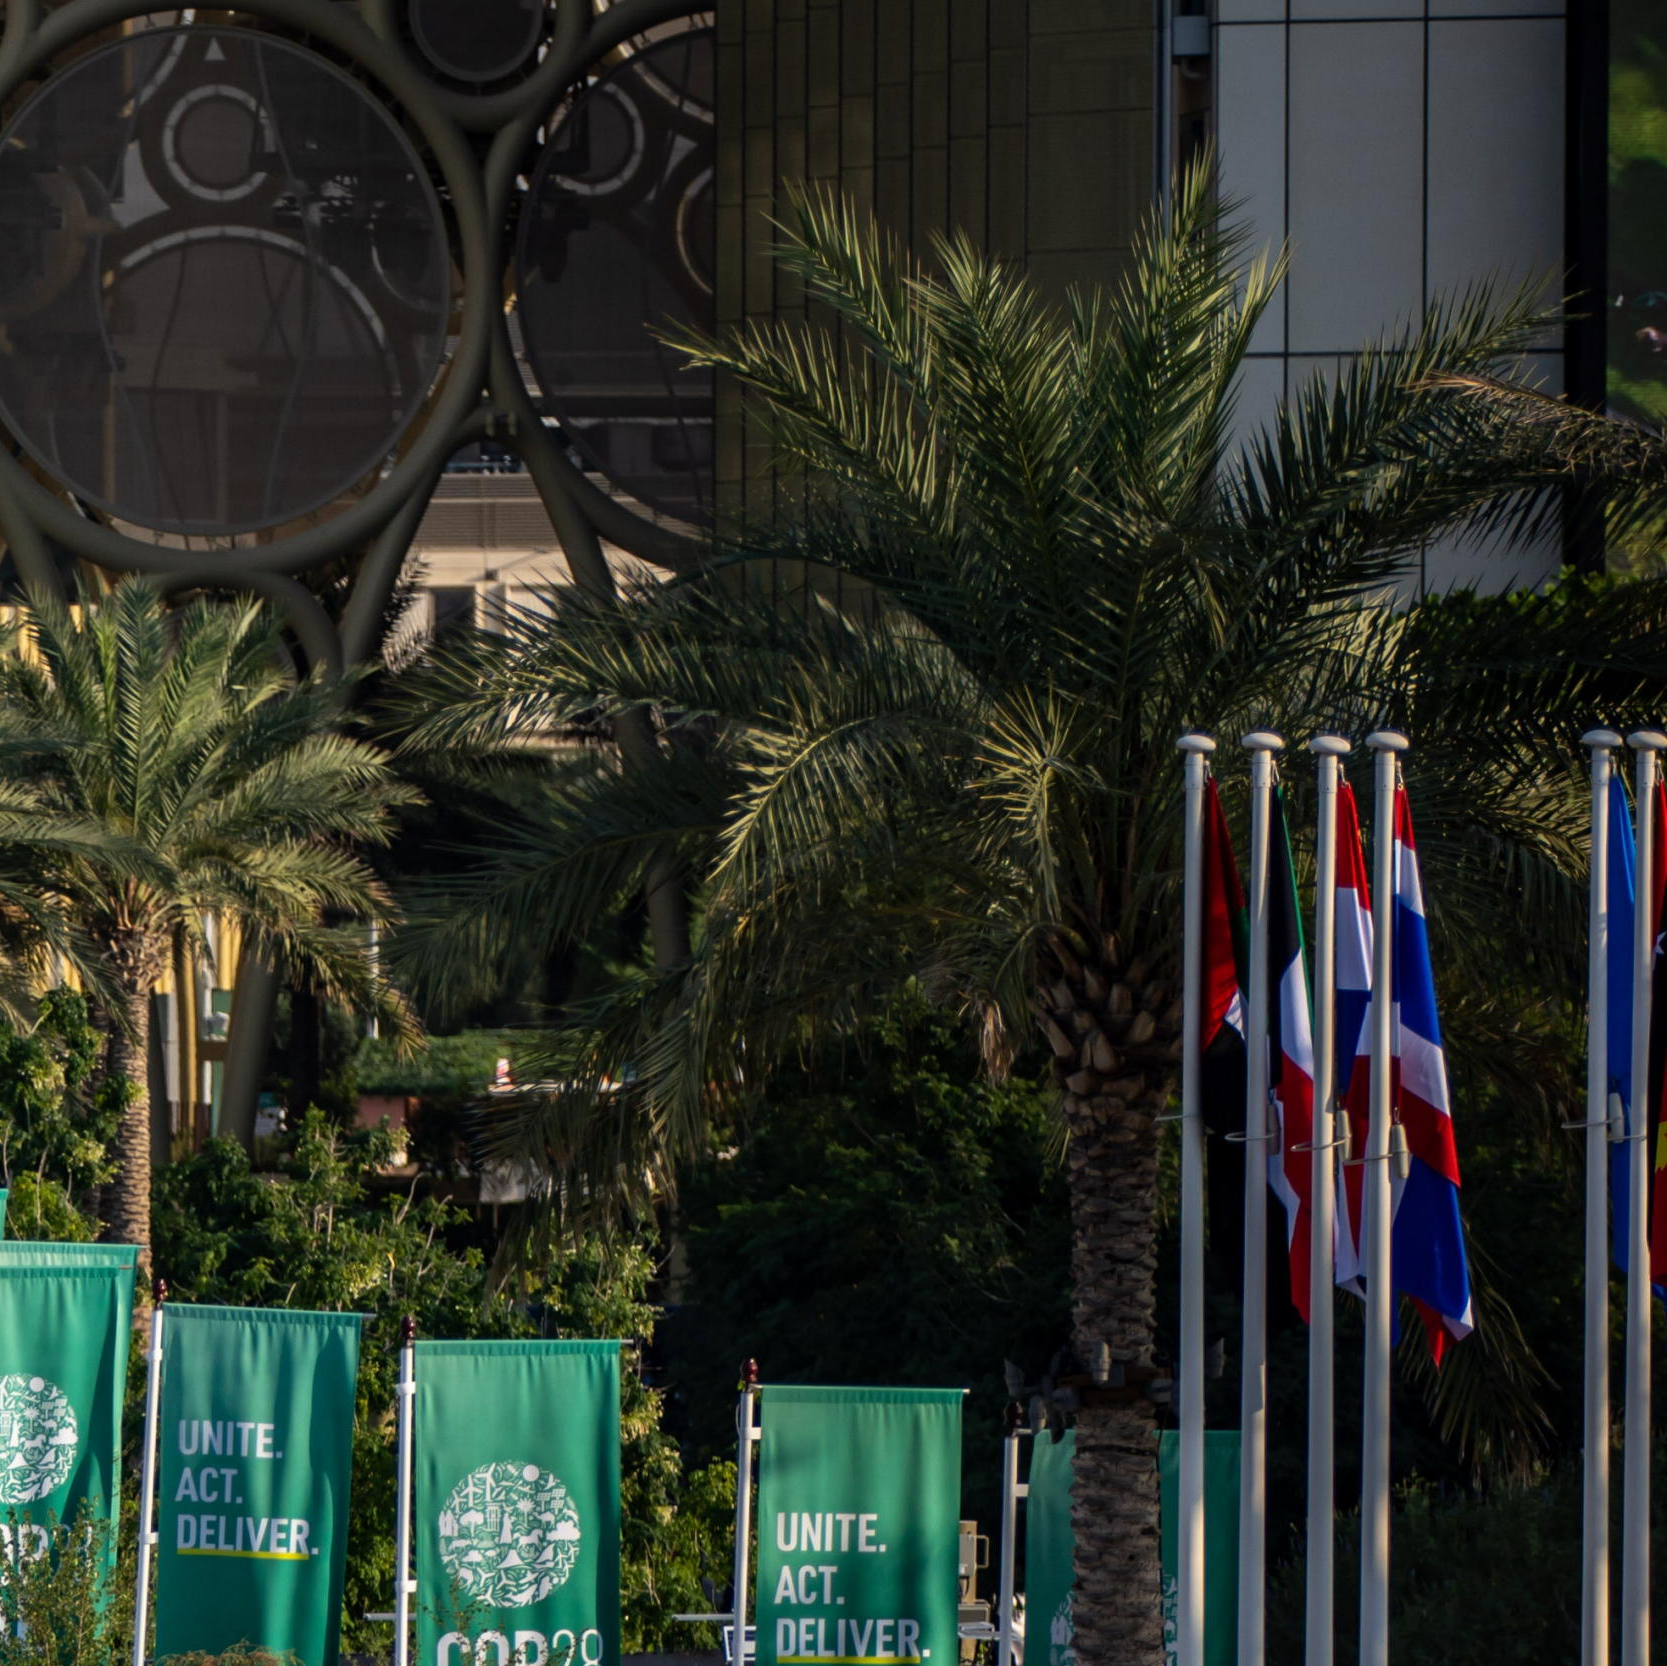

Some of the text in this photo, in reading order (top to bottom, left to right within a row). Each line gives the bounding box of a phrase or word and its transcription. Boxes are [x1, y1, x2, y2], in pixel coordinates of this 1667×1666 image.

[178, 1420, 283, 1459] UNITE.
[176, 1467, 243, 1504] ACT.
[177, 1514, 319, 1555] DELIVER.
[775, 1513, 886, 1553] UNITE.
[774, 1565, 845, 1605] ACT.
[776, 1618, 930, 1659] DELIVER.
